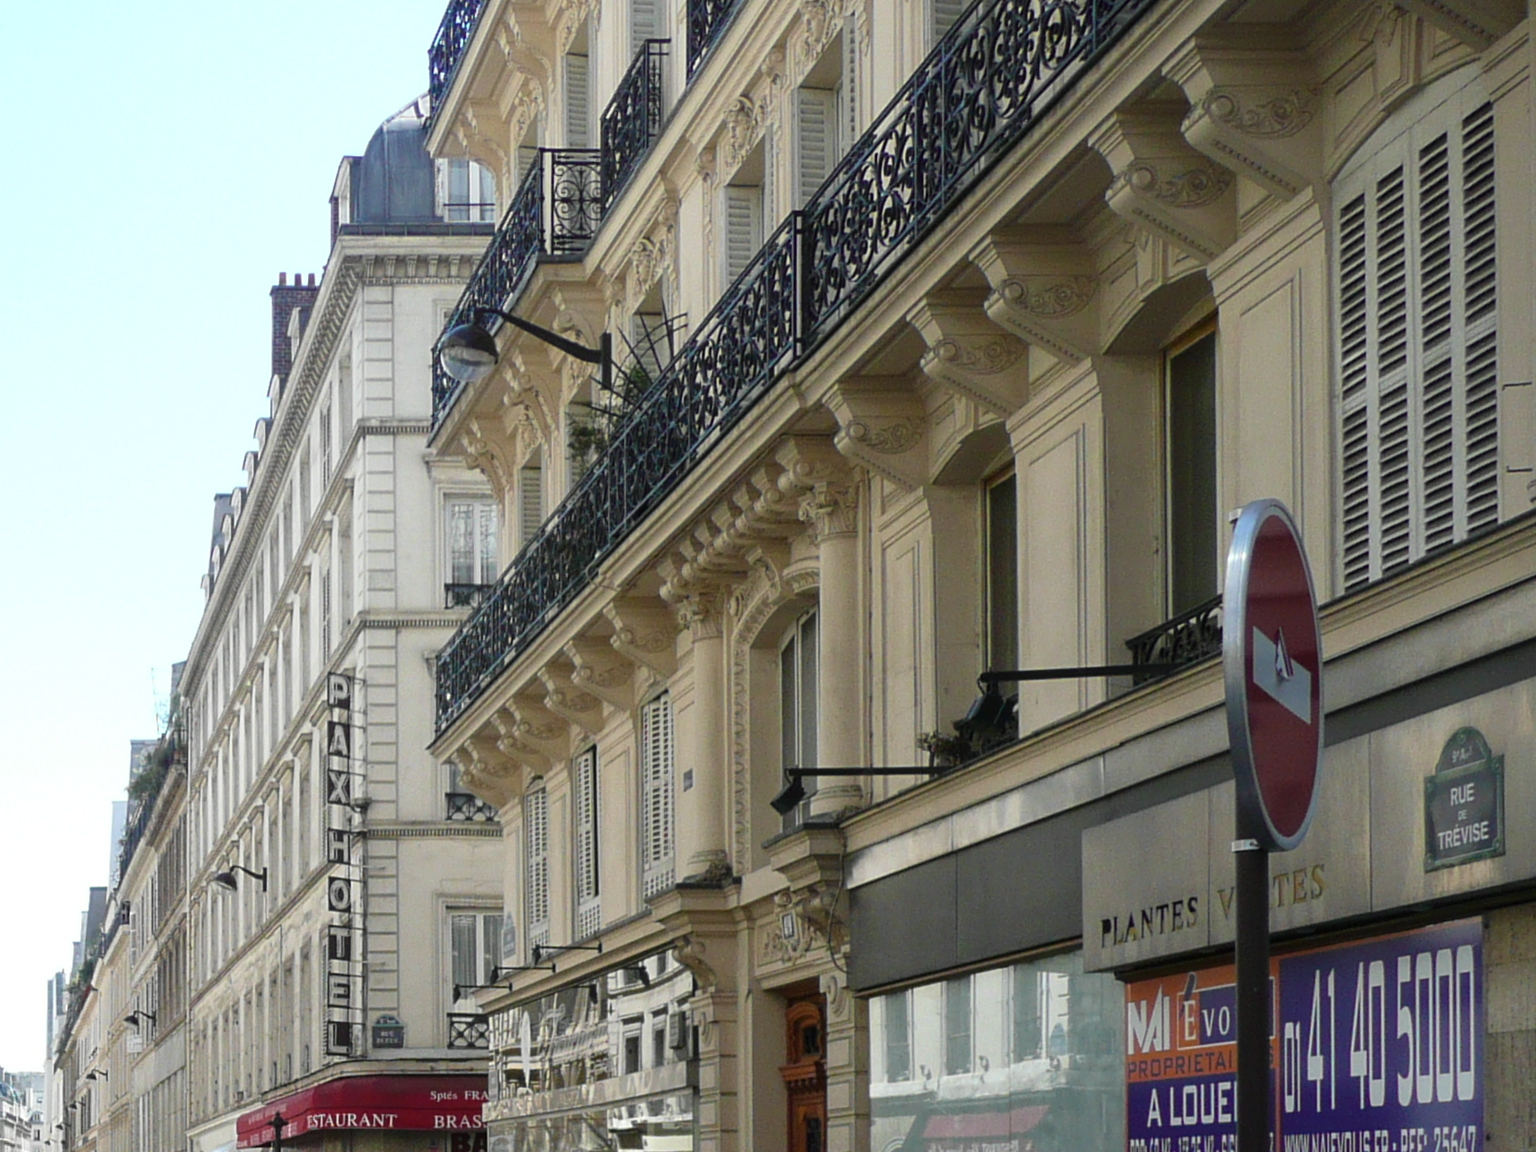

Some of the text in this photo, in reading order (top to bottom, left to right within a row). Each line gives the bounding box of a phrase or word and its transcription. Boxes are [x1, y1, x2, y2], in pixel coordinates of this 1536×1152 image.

[1450, 783, 1475, 806] RUE
[1458, 809, 1467, 820] DE
[329, 674, 351, 1054] PAX HOTEL
[1437, 820, 1489, 850] TRÉVISE
[1101, 864, 1326, 949] PLANTES VTES
[1128, 984, 1170, 1055] NAI
[1284, 944, 1475, 1113] 01 41 40 5000
[1147, 1081, 1238, 1128] A LOUE
